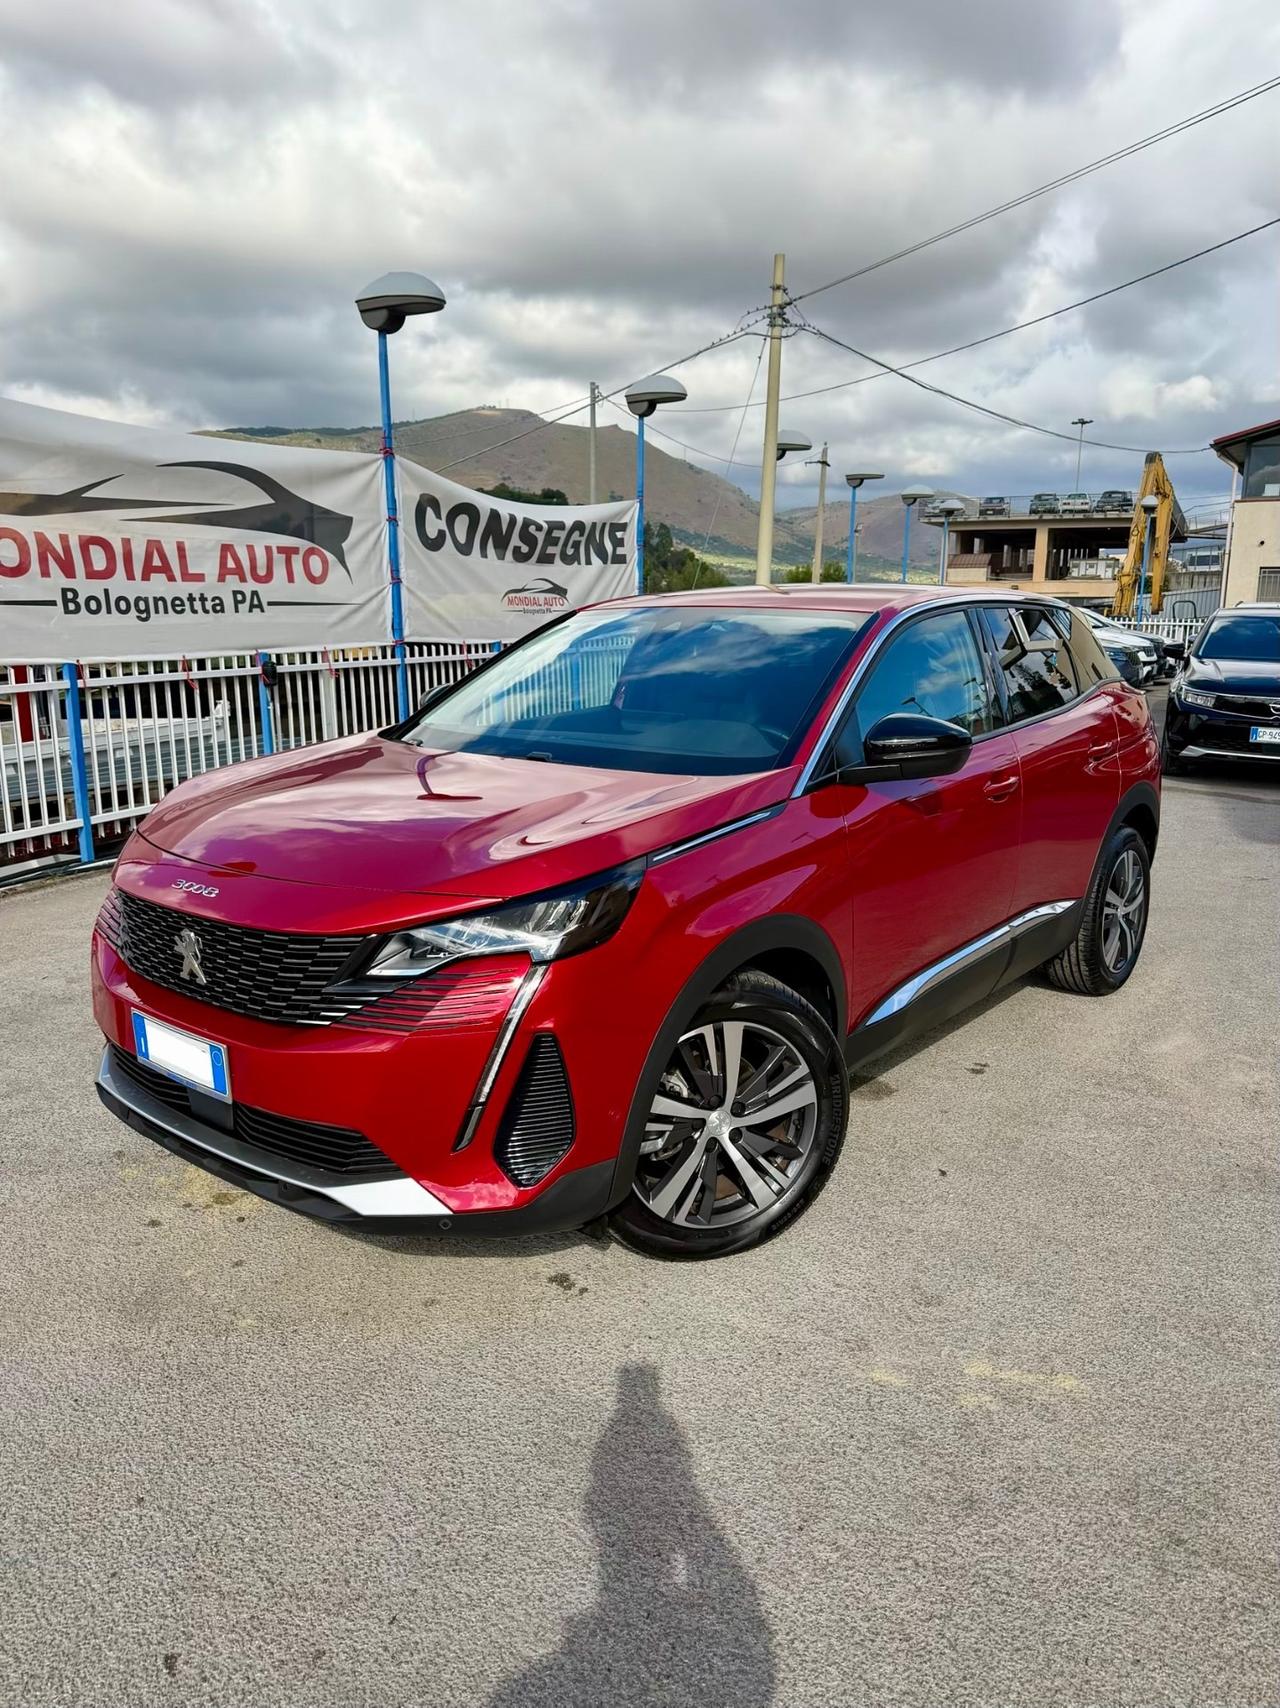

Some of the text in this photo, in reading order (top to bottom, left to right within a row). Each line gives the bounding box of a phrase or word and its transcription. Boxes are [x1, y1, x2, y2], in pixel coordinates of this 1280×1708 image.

[414, 493, 629, 566] CONSEGNE
[216, 543, 330, 585] AUTO
[60, 586, 266, 622] Bolognetta PA
[507, 595, 565, 607] MONDIAL AUTO
[171, 878, 220, 898] 3008
